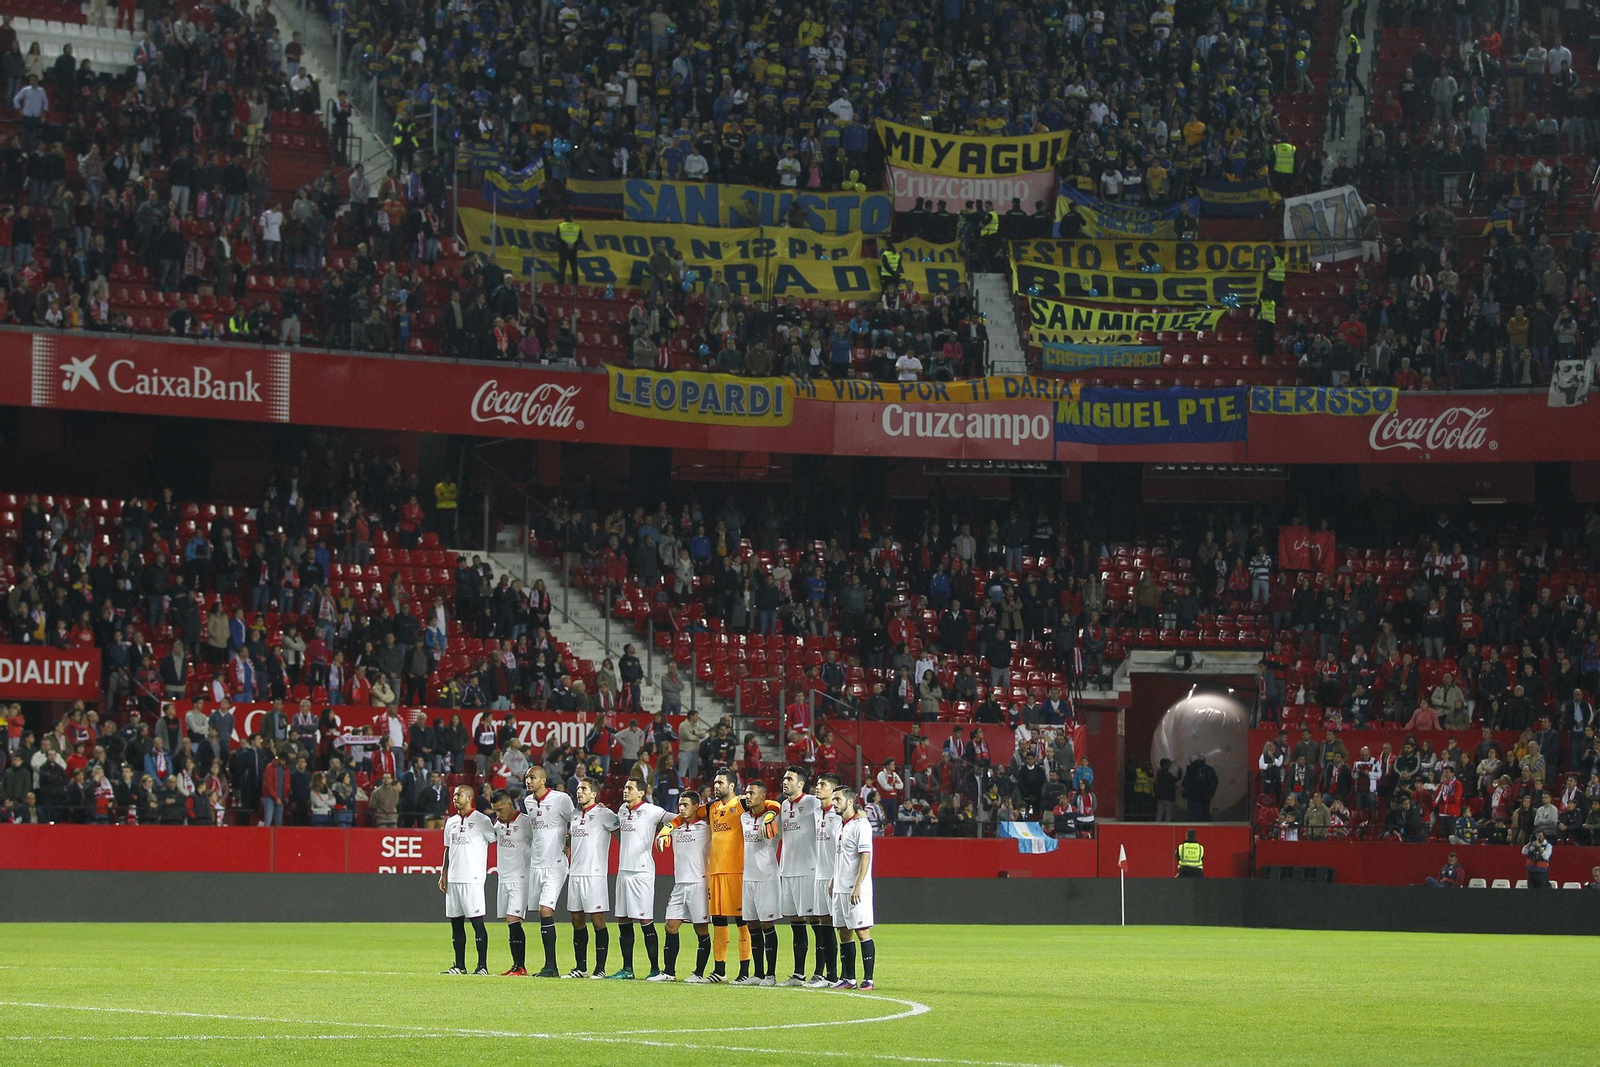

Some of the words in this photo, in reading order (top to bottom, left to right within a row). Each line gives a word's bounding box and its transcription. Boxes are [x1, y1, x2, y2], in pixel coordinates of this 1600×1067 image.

[885, 126, 1062, 174] MIYAGUI
[625, 179, 719, 226] SAN
[893, 170, 1029, 206] Cruzcampo
[1012, 240, 1101, 270] ESTO
[1115, 242, 1160, 273] ES
[1018, 264, 1257, 303] BUDGE
[1030, 299, 1093, 331] SAN
[1098, 311, 1213, 331] MIGUEL
[108, 359, 263, 402] CaixaBank
[616, 372, 784, 416] LEOPARDI
[793, 378, 816, 398] MI
[830, 379, 884, 401] VIDA
[900, 381, 950, 401] POR
[966, 379, 990, 400] TI
[471, 379, 582, 427] Coca-Cola
[1056, 400, 1170, 429] MIGUEL
[1178, 395, 1242, 425] PTE.
[1251, 386, 1393, 415] BERISSO
[882, 404, 1050, 446] Cruzcampo
[1369, 407, 1494, 450] Coca-Cola
[381, 836, 422, 858] SEE
